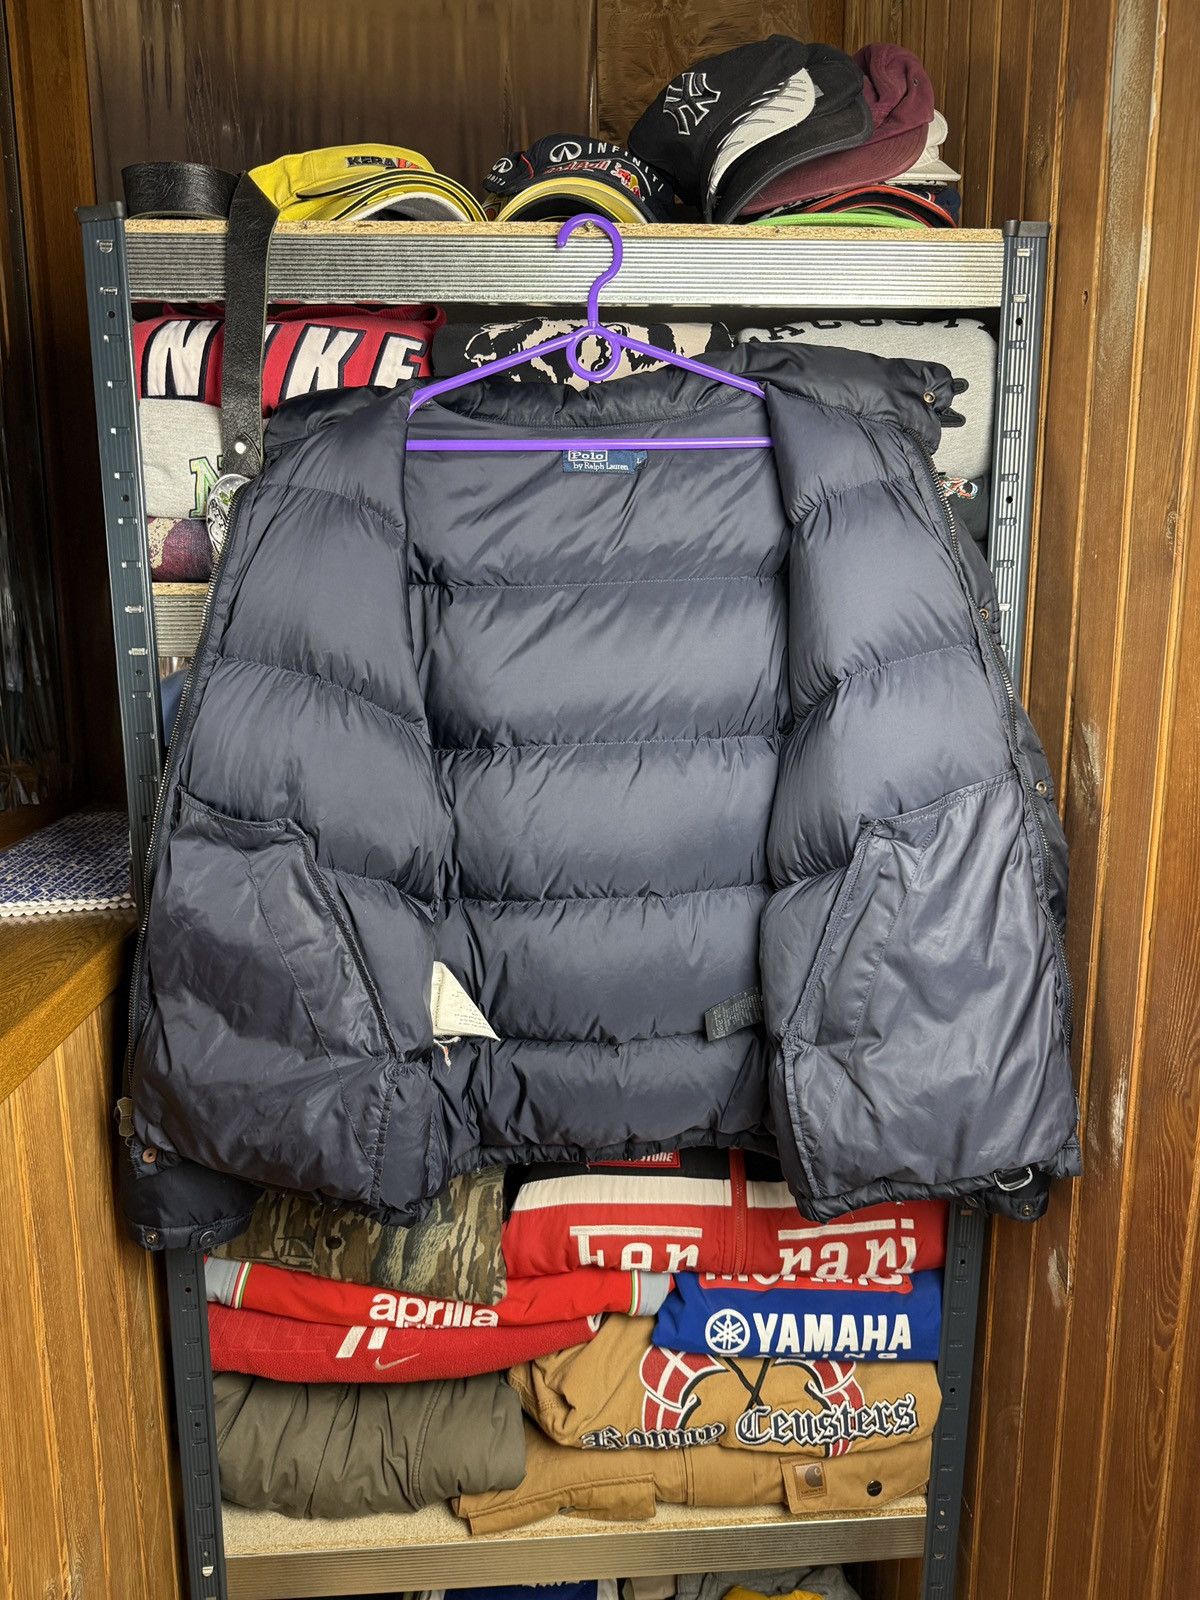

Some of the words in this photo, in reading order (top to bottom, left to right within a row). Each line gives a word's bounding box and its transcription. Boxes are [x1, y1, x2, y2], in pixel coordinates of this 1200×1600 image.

[140, 319, 424, 400] NKE
[571, 451, 604, 460] Polo
[573, 462, 583, 470] by
[584, 462, 605, 471] Ralph
[606, 462, 629, 471] Lauren
[369, 1292, 499, 1329] aprilia
[752, 1312, 912, 1353] YAMAHA
[735, 1393, 922, 1448] Ceusters
